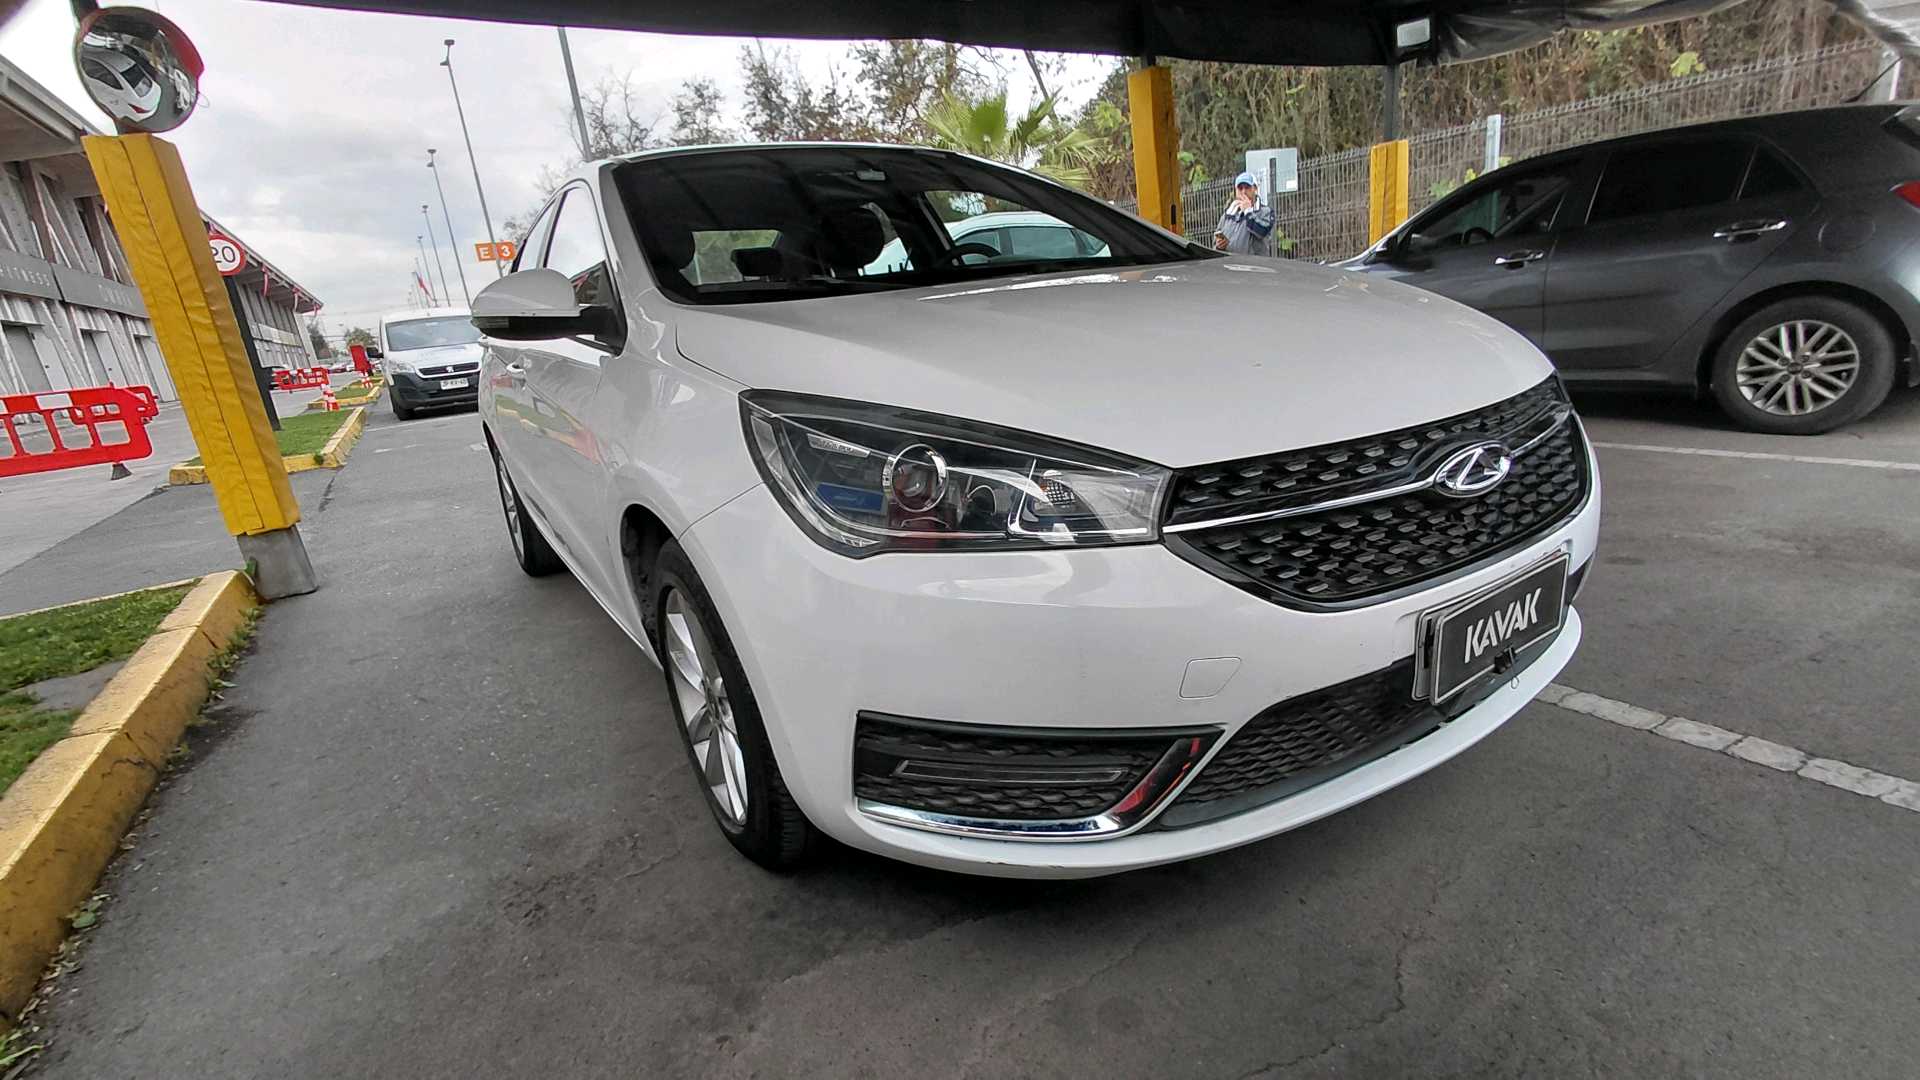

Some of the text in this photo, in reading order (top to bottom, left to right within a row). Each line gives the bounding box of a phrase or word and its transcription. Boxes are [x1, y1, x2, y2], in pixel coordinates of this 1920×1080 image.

[478, 245, 511, 259] E 3
[1464, 587, 1542, 664] KAVAK
